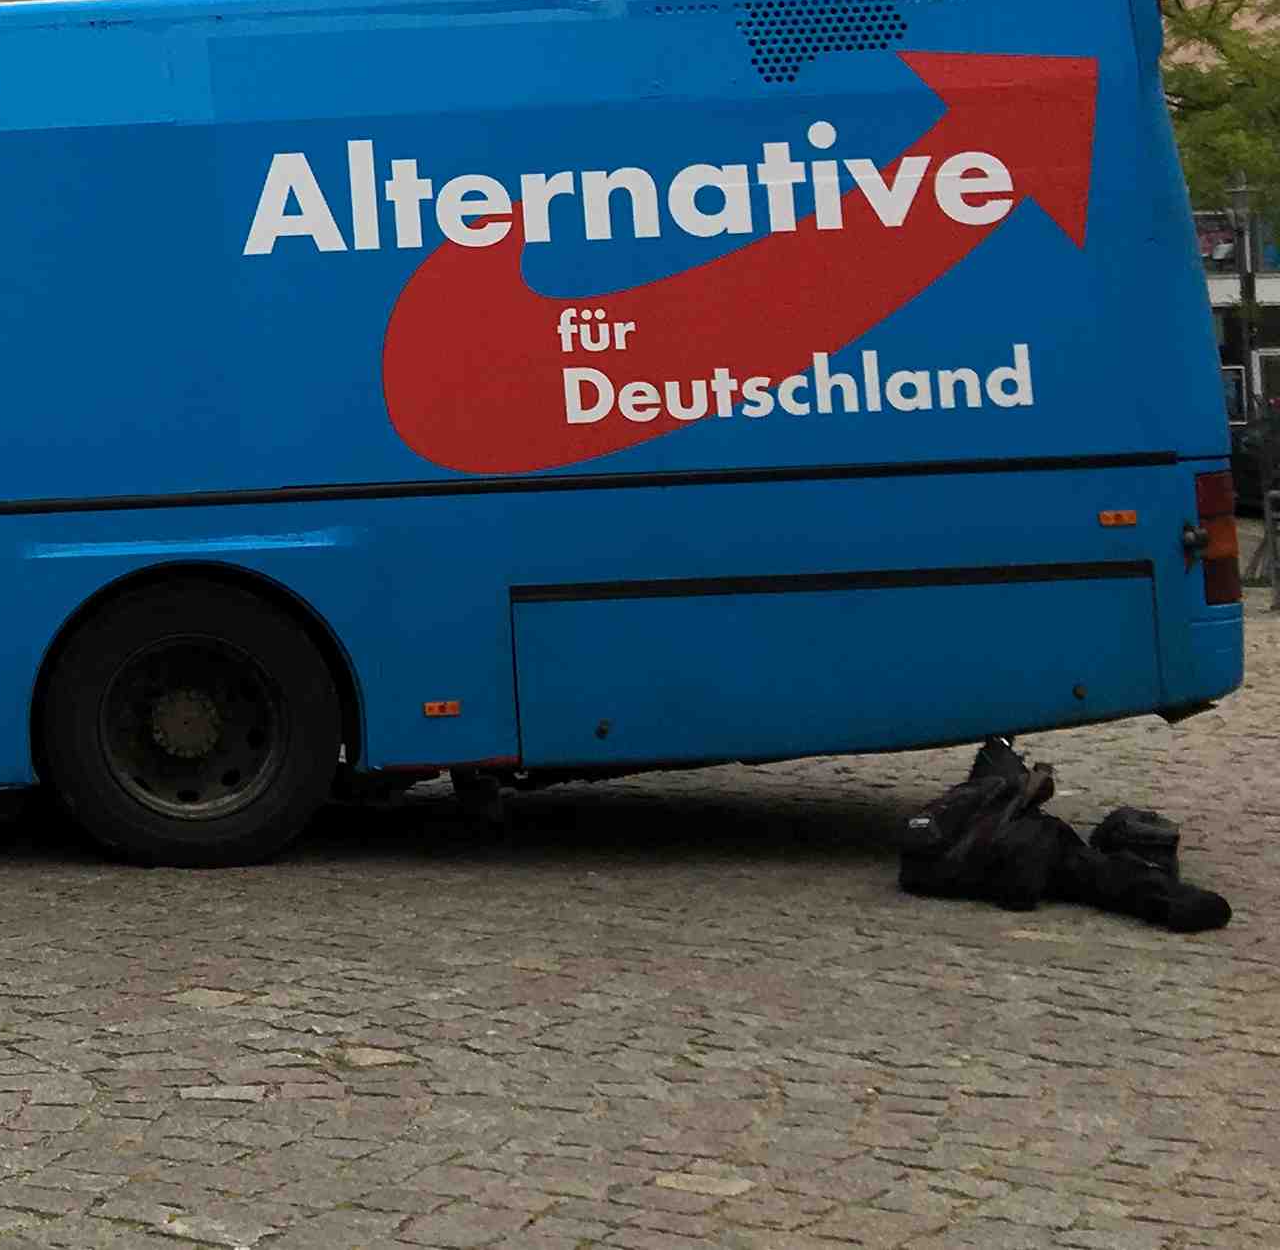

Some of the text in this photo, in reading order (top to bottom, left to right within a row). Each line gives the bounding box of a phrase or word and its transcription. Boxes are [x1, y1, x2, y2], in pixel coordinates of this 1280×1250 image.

[243, 121, 1014, 255] Alternative
[557, 308, 636, 352] für
[563, 343, 1033, 424] Deutschland
